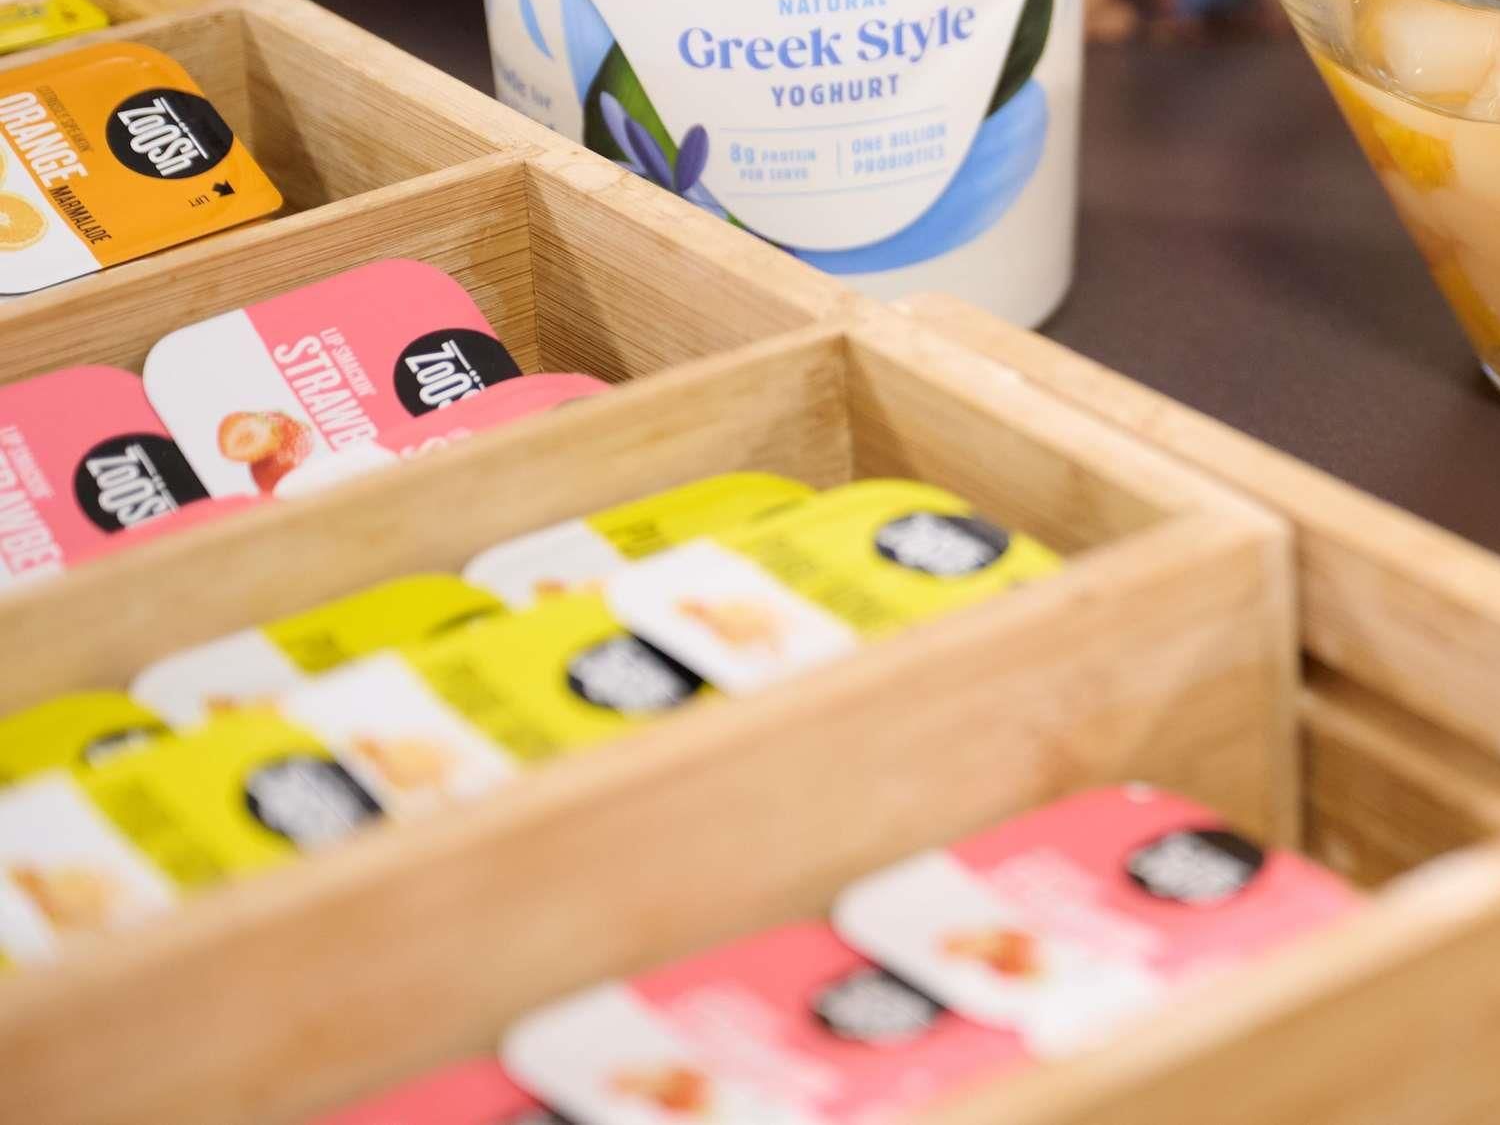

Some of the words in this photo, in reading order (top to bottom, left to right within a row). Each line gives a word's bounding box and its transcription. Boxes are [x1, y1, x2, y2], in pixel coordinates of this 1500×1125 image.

[677, 27, 842, 71] Greek
[856, 5, 976, 63] Style
[771, 73, 901, 108] YOGHURT
[0, 91, 89, 188] ORANGE
[49, 184, 113, 245] MARMALADE
[319, 326, 346, 351] LIP
